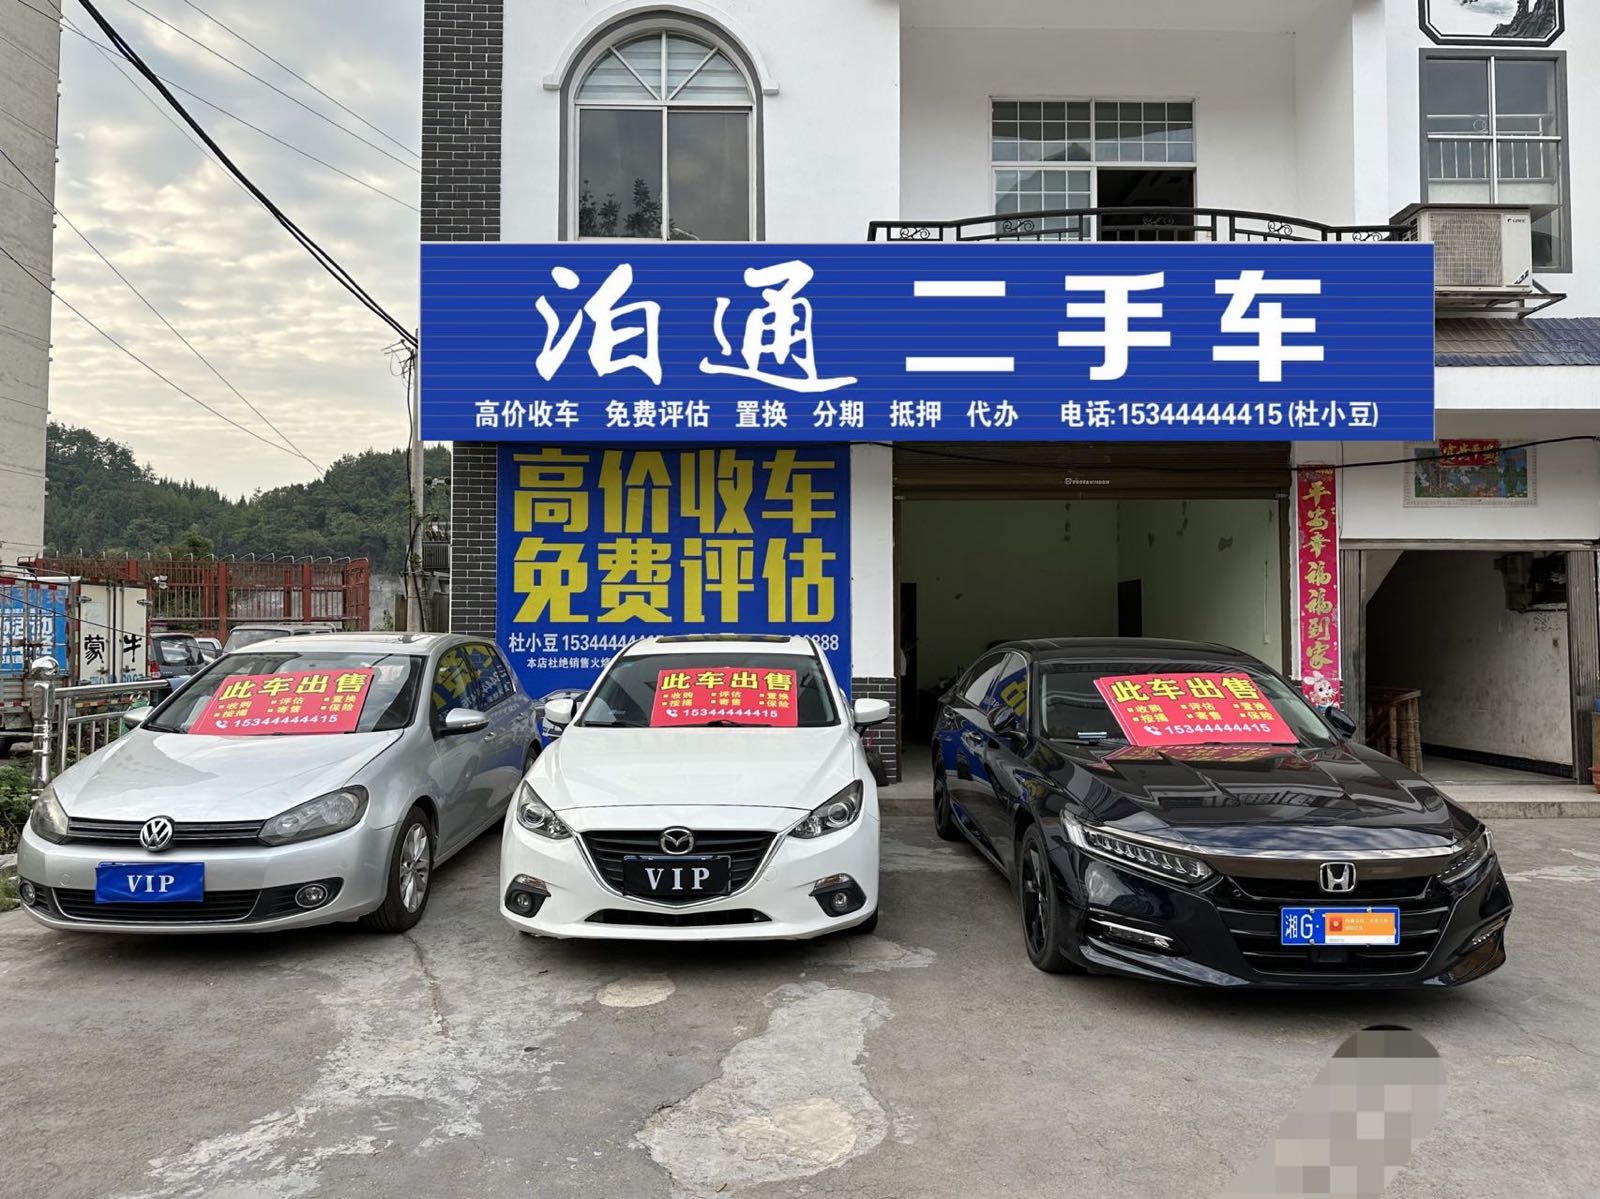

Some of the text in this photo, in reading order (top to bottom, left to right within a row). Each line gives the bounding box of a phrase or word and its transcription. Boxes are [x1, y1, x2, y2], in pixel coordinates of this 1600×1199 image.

[475, 400, 579, 427] 高价收车
[605, 400, 710, 427] 免费评估
[735, 400, 788, 427] 置换
[813, 400, 864, 427] 分期
[889, 400, 941, 427] 抵押
[966, 400, 1019, 427] 代办
[513, 448, 836, 533] 高价收车
[513, 537, 835, 623] 免费评估
[508, 632, 558, 653] 杜小豆
[219, 673, 368, 701] 此车出售
[660, 672, 793, 691] 此车出售
[1110, 677, 1260, 703] 此车出售
[233, 714, 338, 728] 15344444415
[682, 708, 778, 718] 15344444415
[1164, 723, 1272, 735] 15344444415
[126, 874, 175, 893] VIP
[644, 867, 711, 891] VIP
